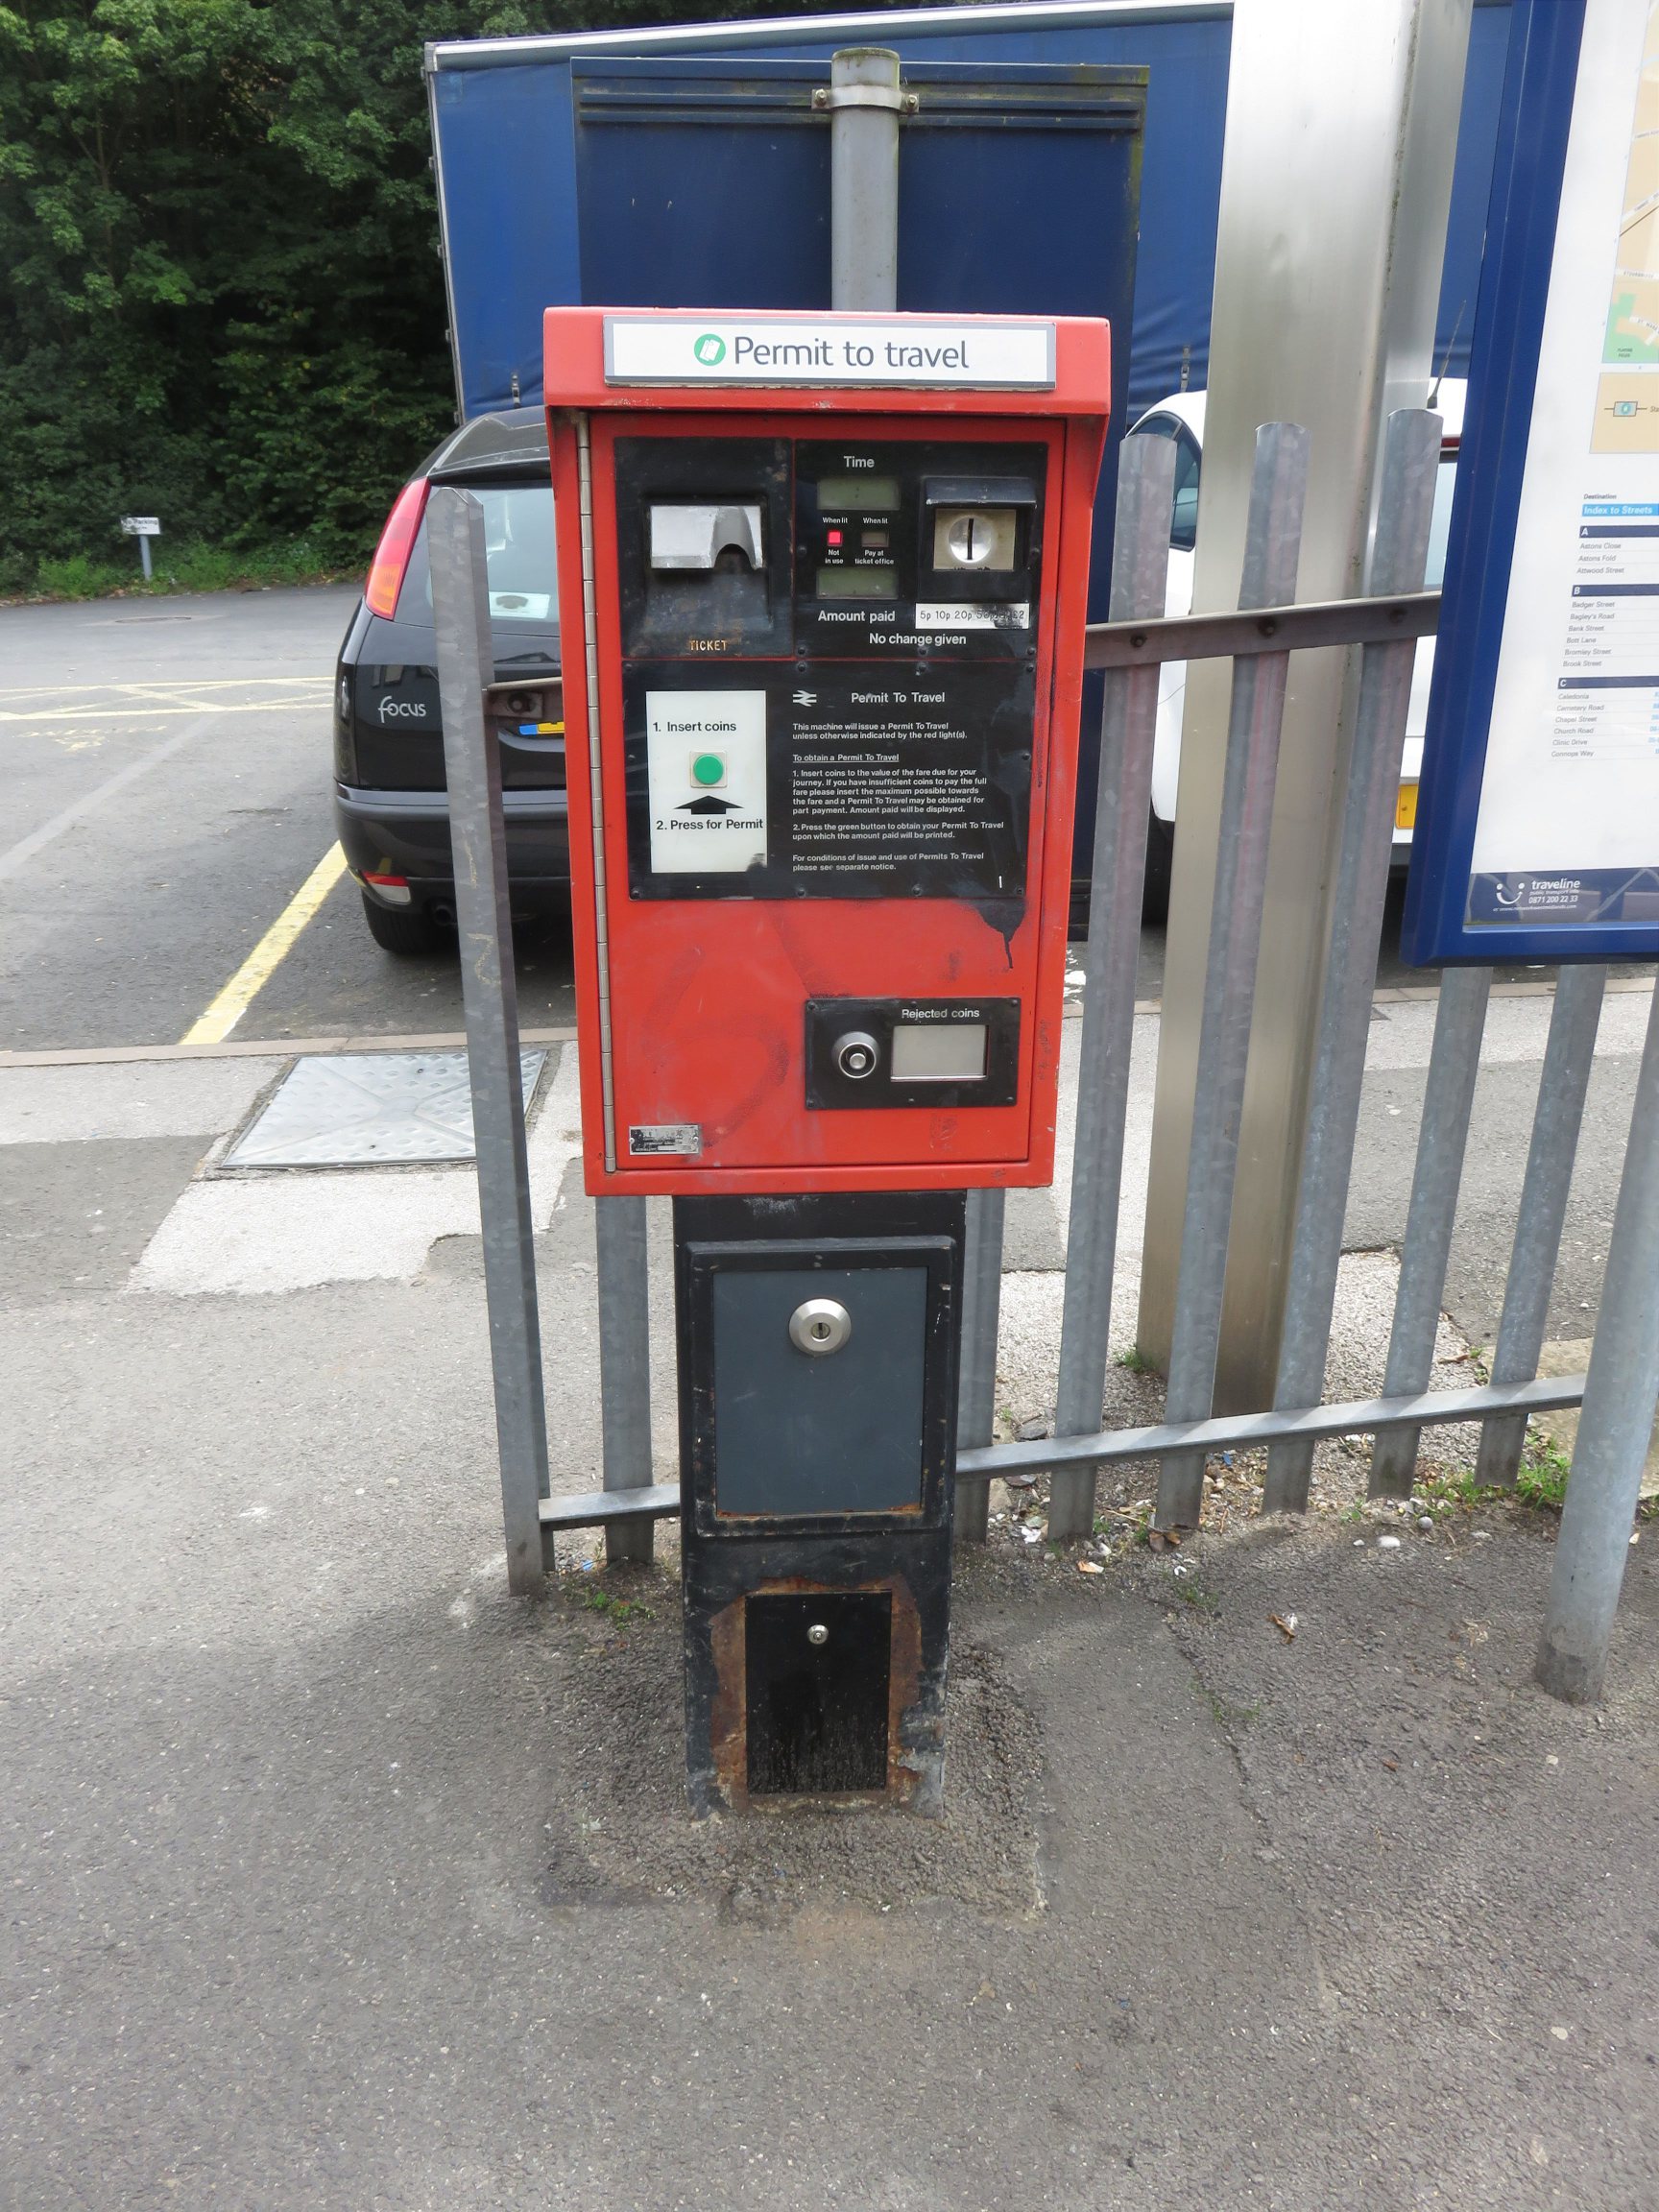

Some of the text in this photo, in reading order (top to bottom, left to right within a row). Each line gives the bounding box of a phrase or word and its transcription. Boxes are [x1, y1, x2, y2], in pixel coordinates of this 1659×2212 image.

[735, 336, 970, 369] Permit to travel
[843, 456, 875, 468] Time
[1585, 506, 1607, 514] Index
[1622, 505, 1652, 514] Streets
[1581, 528, 1589, 536] A
[1574, 587, 1581, 595] B
[818, 610, 895, 624] Amount paid
[920, 610, 931, 621] 5p
[935, 610, 953, 621] 10p
[954, 609, 973, 621] 20p
[869, 633, 967, 646] No change given
[688, 640, 729, 651] TICKET
[851, 692, 945, 703] Permit To Travel
[652, 721, 737, 732] 1. Insert coins
[897, 732, 908, 740] by
[939, 731, 967, 740] light(s).
[793, 779, 824, 787] journey.
[914, 787, 946, 796] possible
[882, 806, 898, 814] paid
[926, 806, 965, 814] displayed.
[657, 819, 763, 830] 2. Press for Permit
[882, 832, 899, 840] paid
[925, 831, 955, 839] printed.
[1532, 878, 1580, 890] traveline
[901, 1008, 980, 1020] Rejected coins
